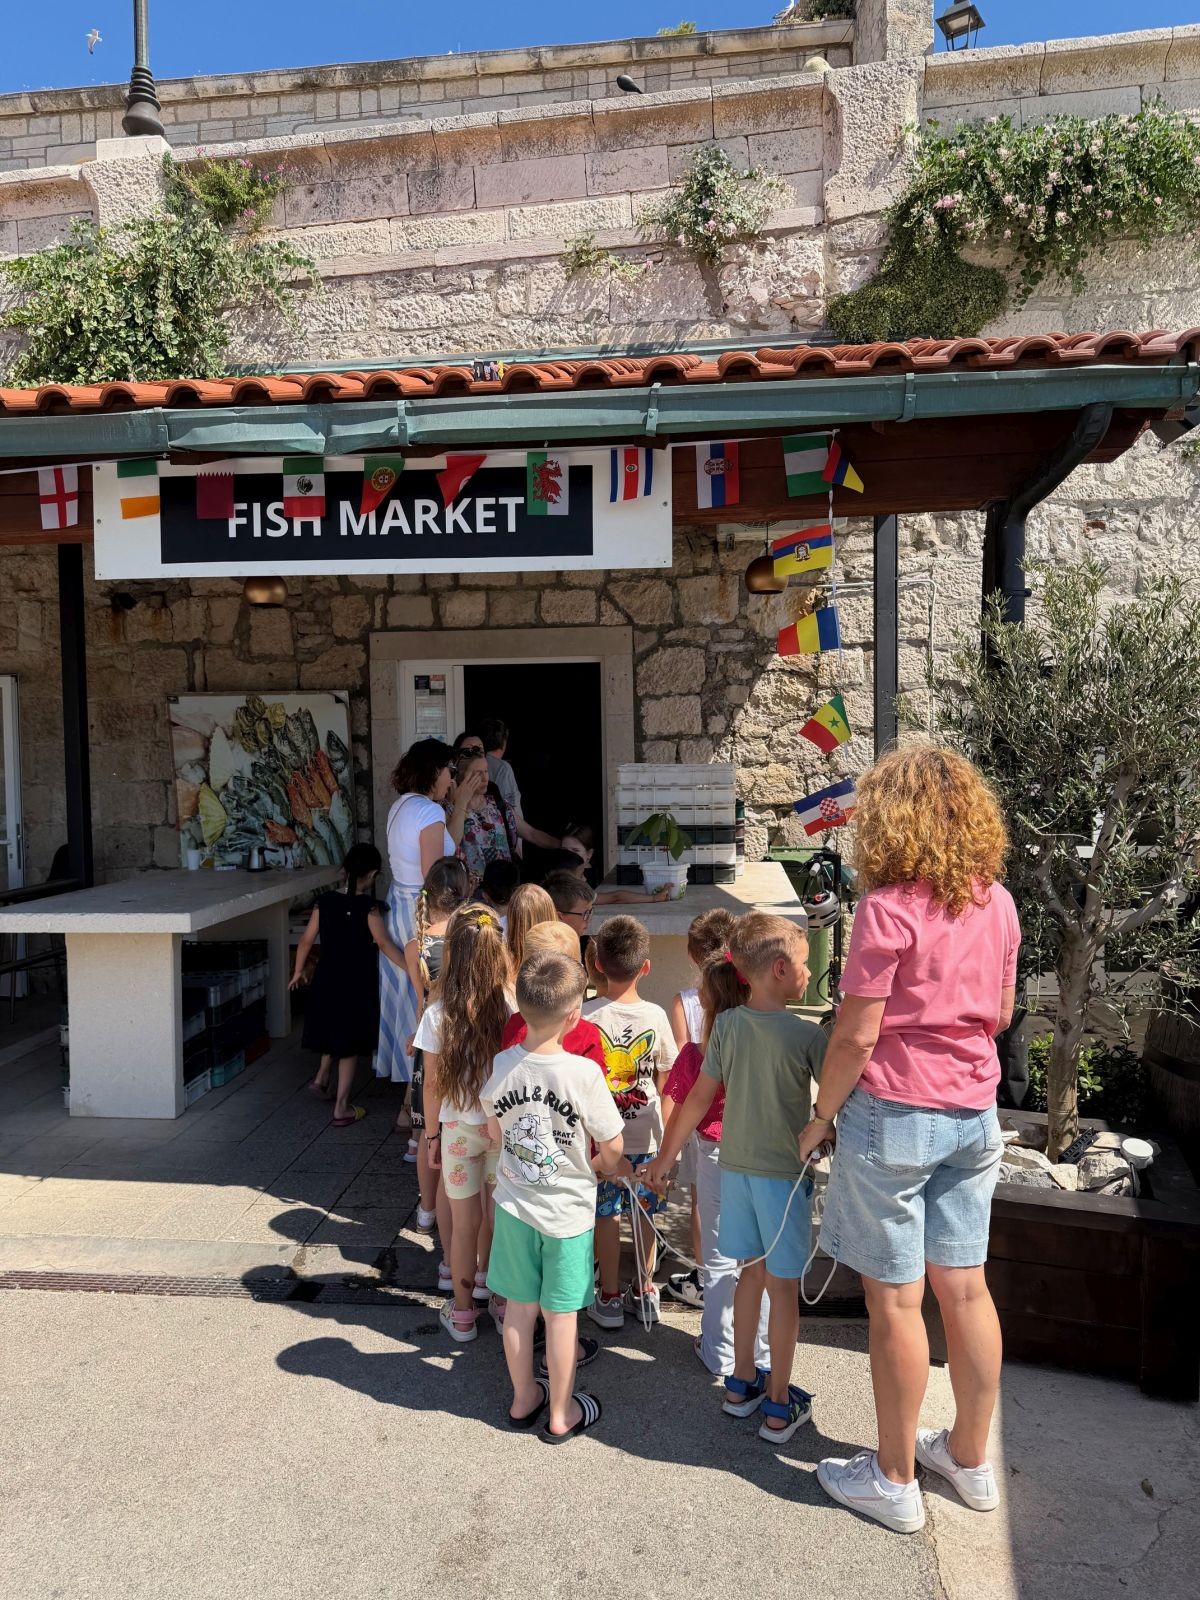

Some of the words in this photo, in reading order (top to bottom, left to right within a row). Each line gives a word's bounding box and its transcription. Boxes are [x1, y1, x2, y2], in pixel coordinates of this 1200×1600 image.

[228, 501, 322, 538] FISH
[339, 496, 525, 536] MARKET
[493, 1085, 531, 1118] CHILL
[531, 1085, 543, 1102] &
[543, 1089, 580, 1128] RIDE
[552, 1129, 576, 1139] SKATE
[554, 1137, 573, 1147] TIME
